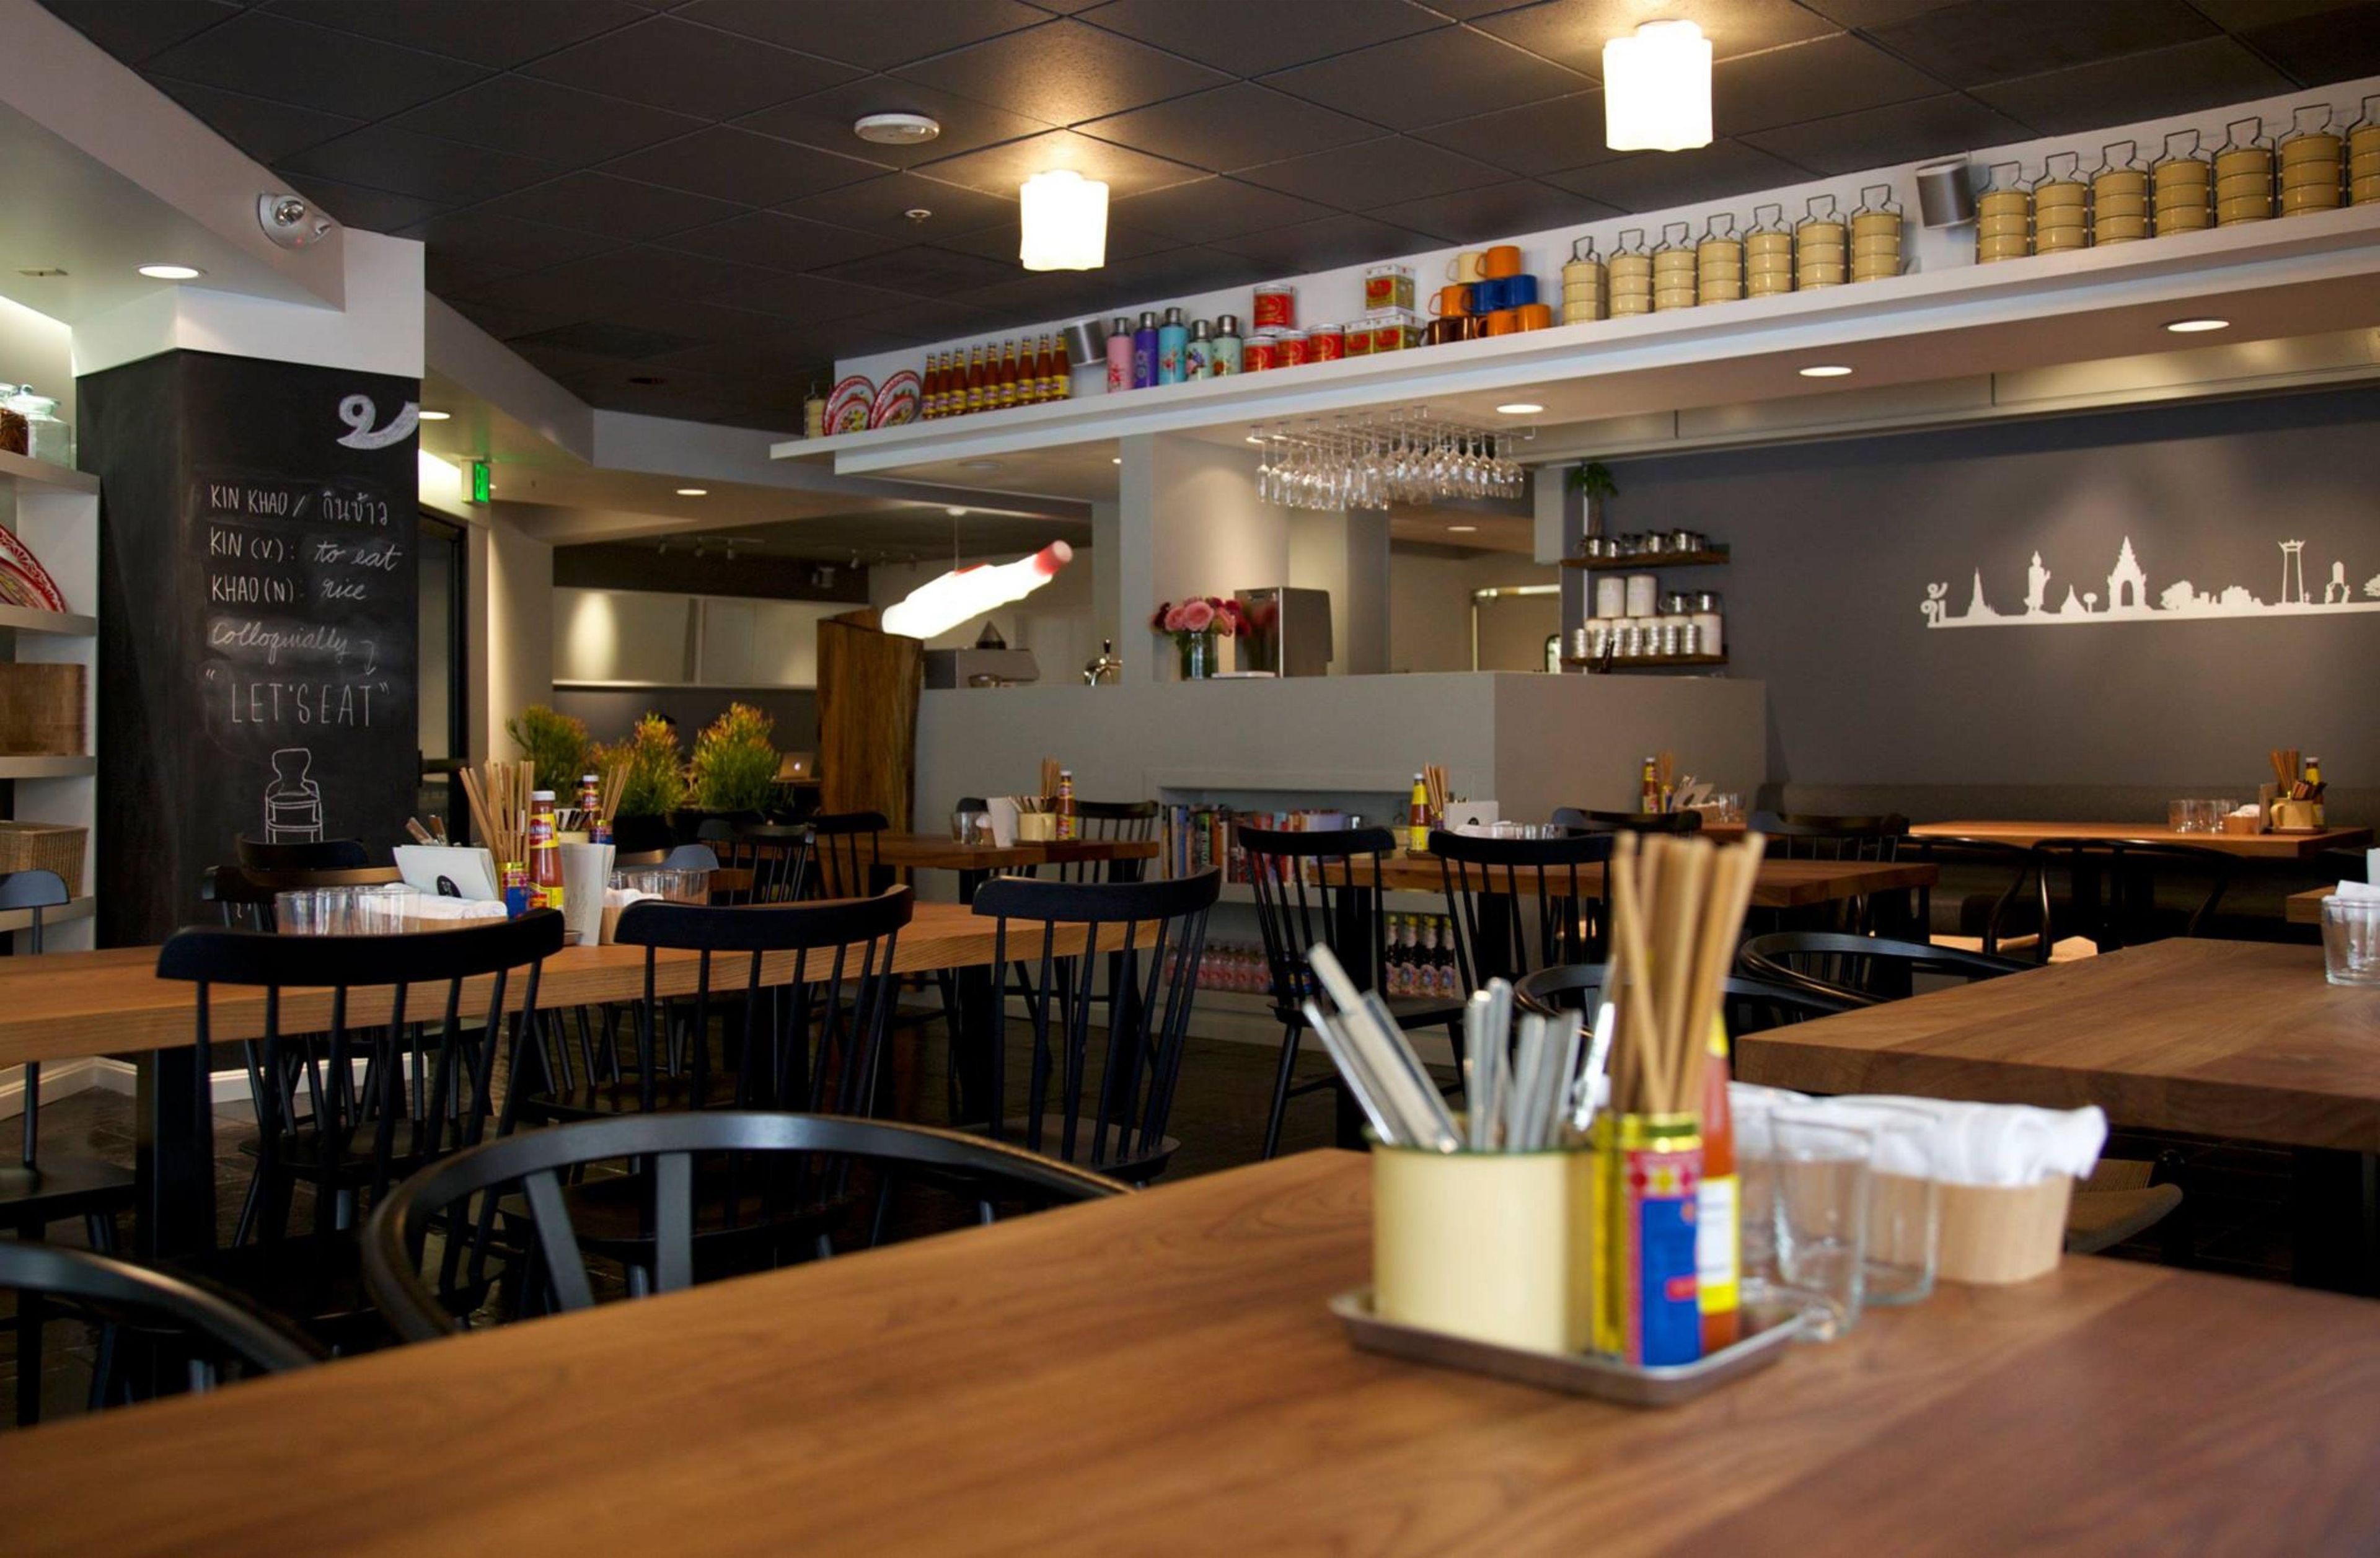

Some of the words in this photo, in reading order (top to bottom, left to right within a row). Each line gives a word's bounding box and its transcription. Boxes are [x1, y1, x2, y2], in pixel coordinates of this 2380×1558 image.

[211, 484, 239, 509] KIN
[248, 489, 288, 516] KHAO
[211, 526, 242, 558] KIN
[314, 540, 346, 563] to
[350, 544, 402, 571] eat
[319, 578, 367, 600] rice
